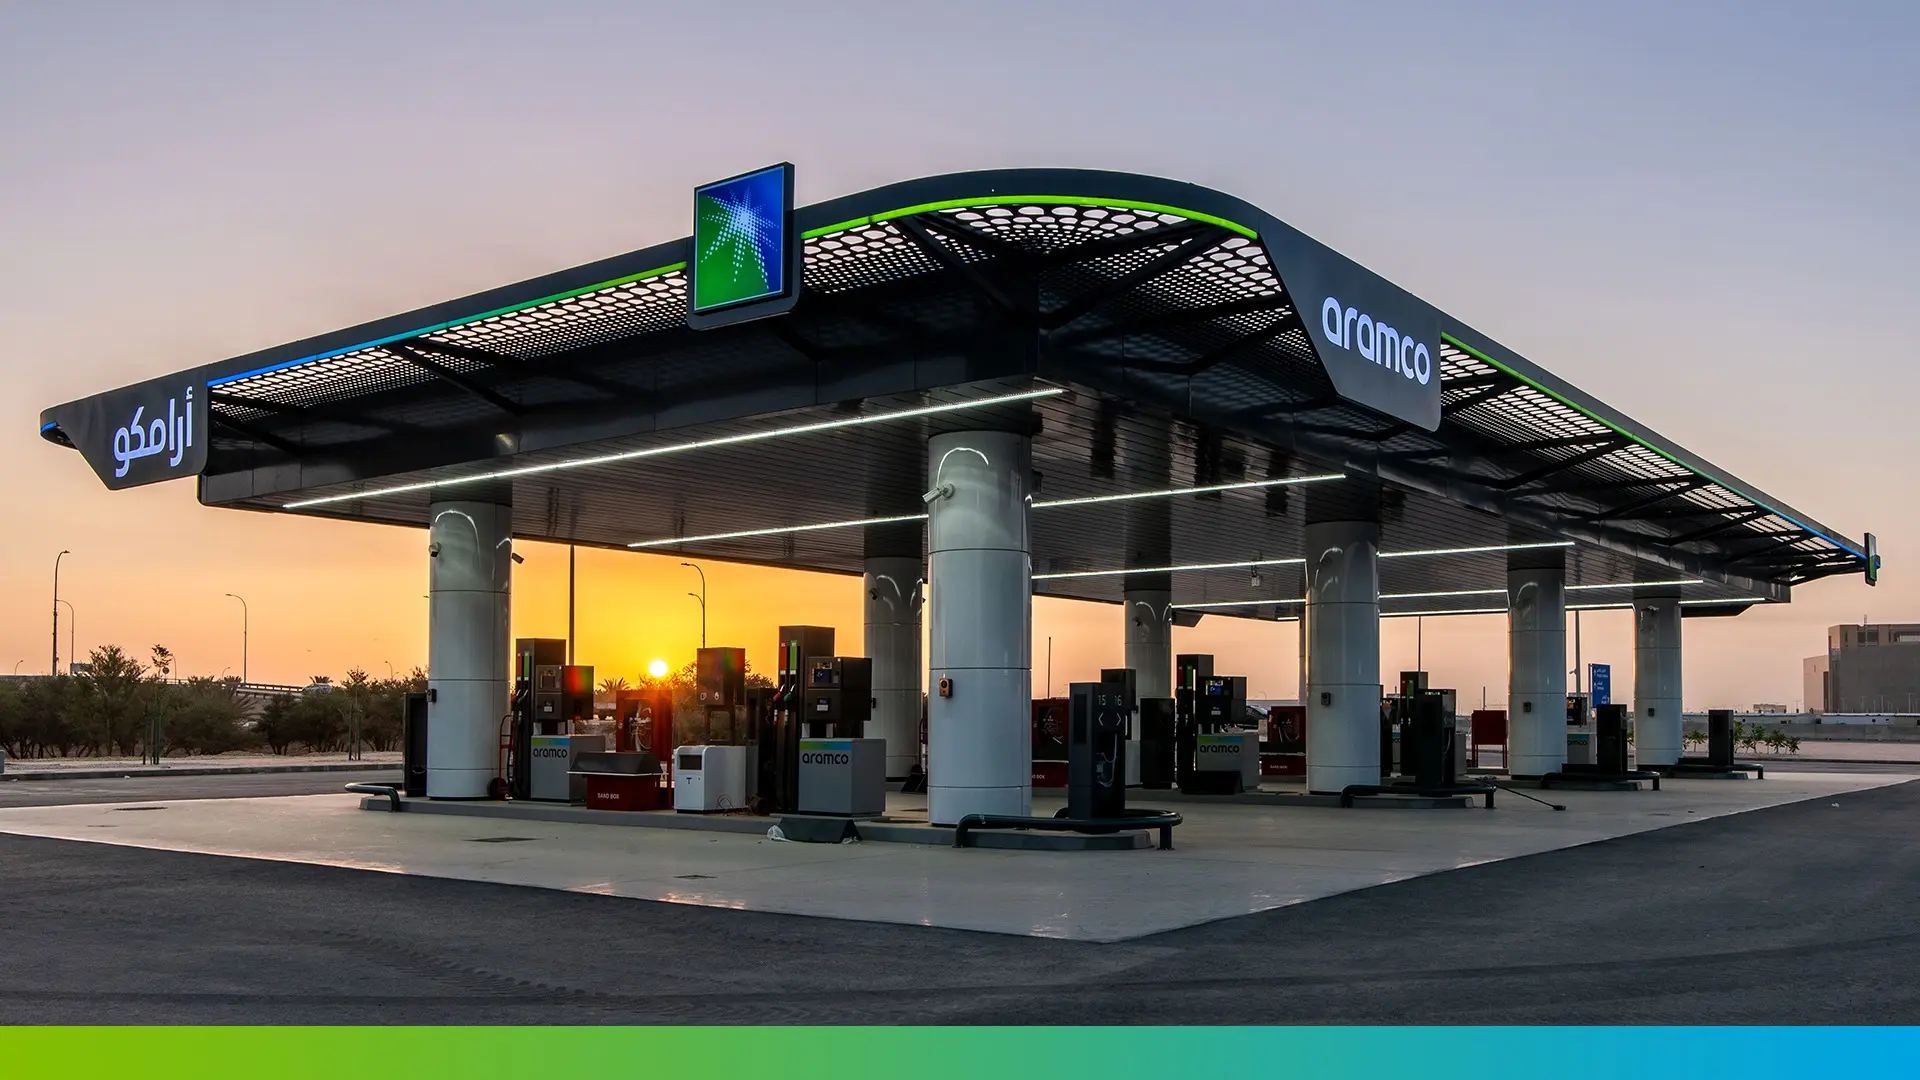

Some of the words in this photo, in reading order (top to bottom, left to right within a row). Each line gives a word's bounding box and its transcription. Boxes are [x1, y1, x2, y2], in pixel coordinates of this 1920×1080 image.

[1322, 296, 1431, 385] aramco
[113, 385, 193, 478] أرامكو
[1098, 694, 1107, 706] 15
[1114, 694, 1122, 706] 16
[533, 747, 568, 758] aramco
[1200, 744, 1240, 753] aramco
[801, 752, 849, 765] aramco
